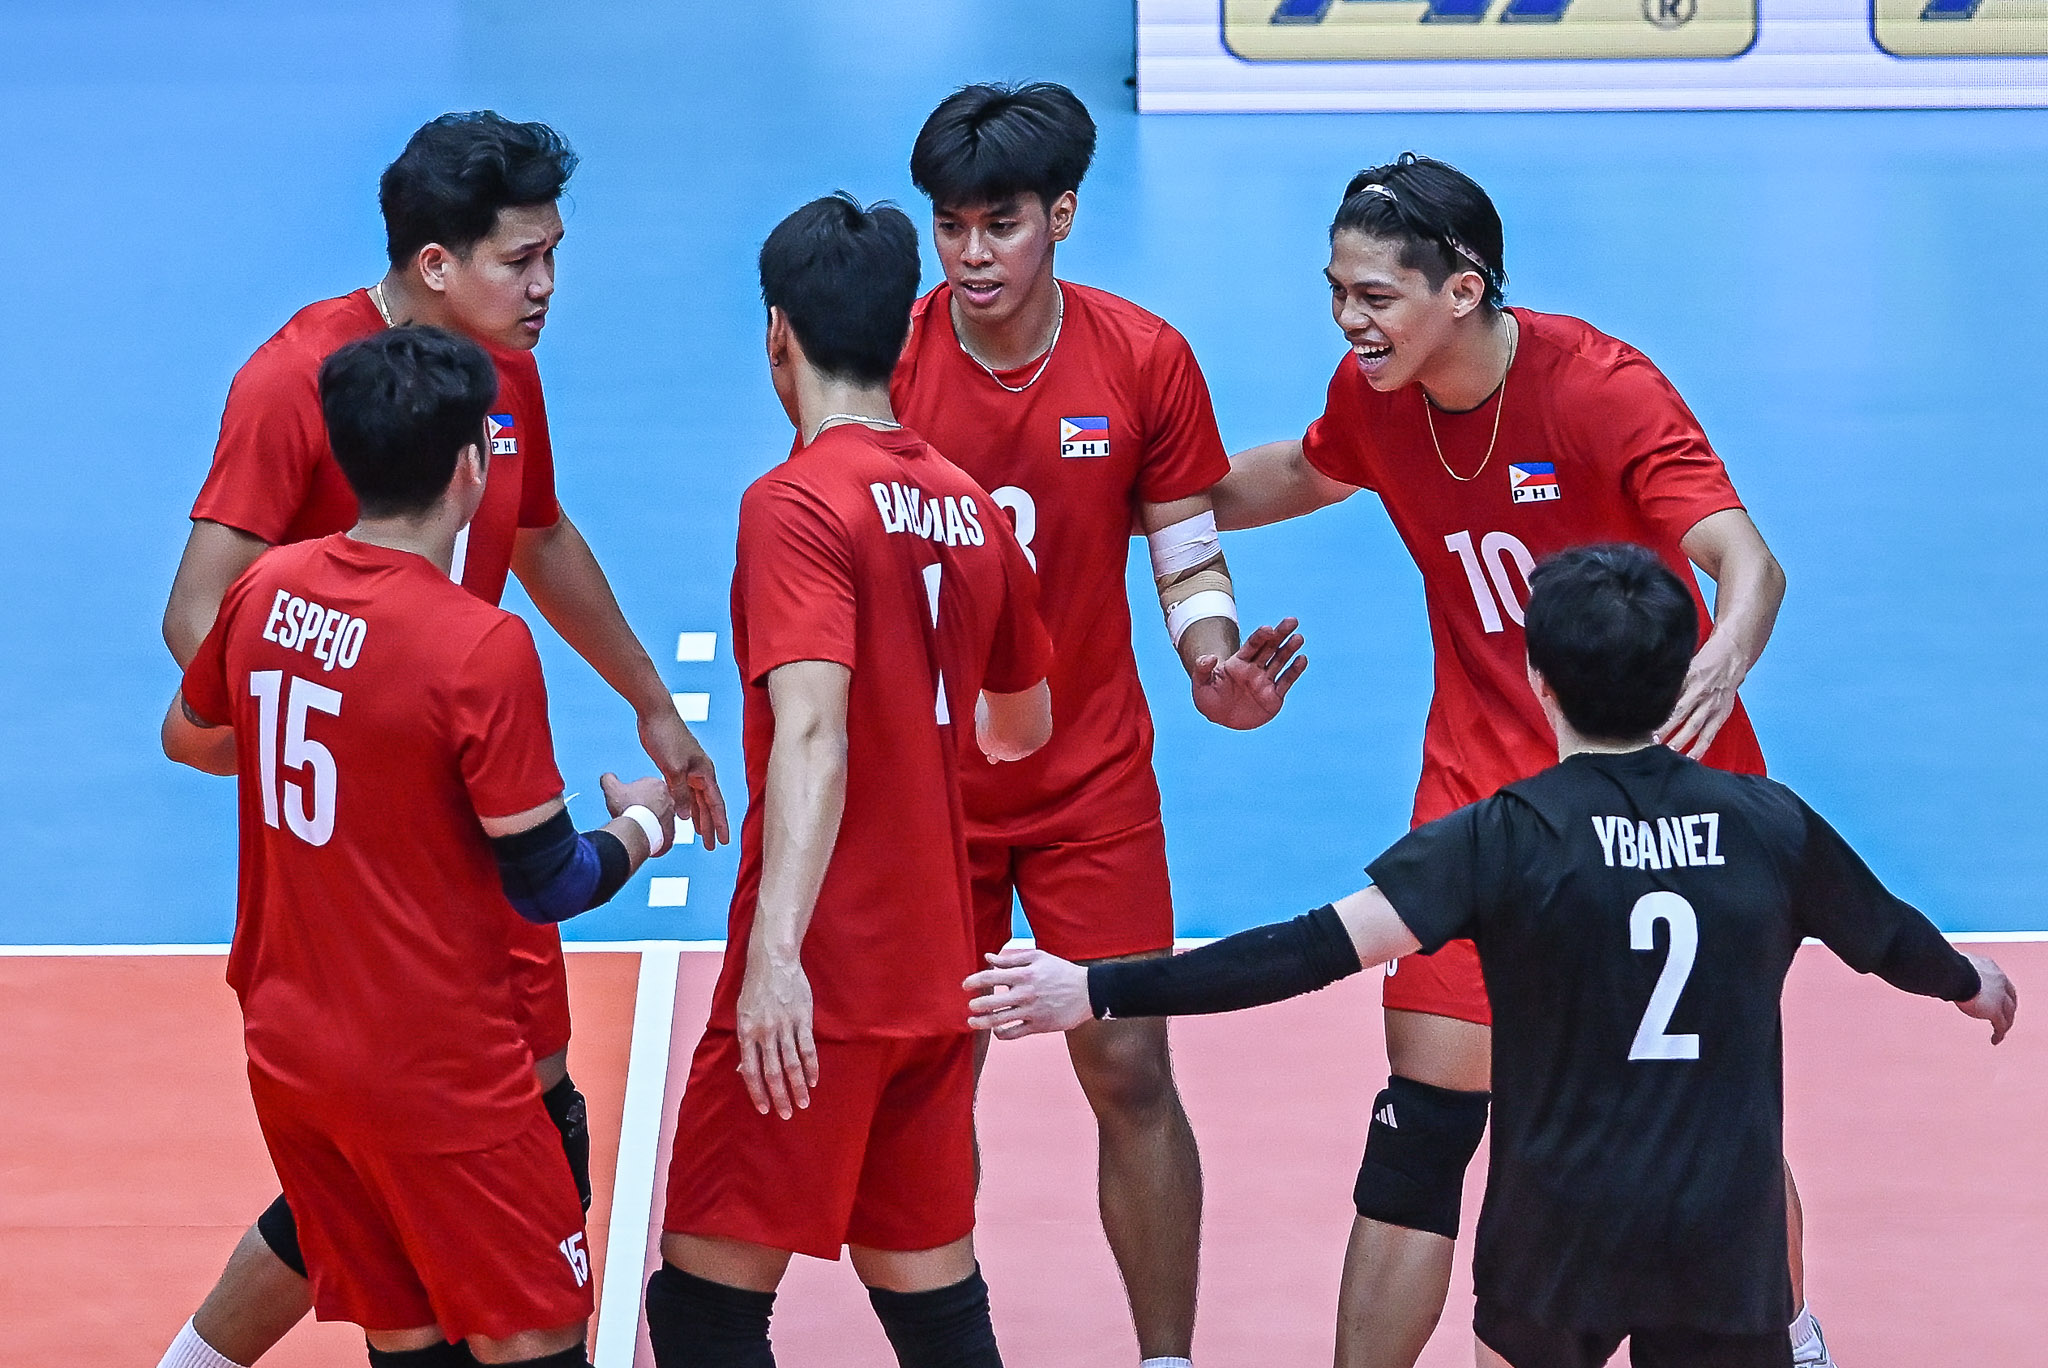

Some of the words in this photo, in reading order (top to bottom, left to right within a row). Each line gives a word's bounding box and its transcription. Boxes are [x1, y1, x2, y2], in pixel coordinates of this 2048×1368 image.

[491, 440, 518, 453] PHI
[1062, 442, 1109, 455] PHI
[1513, 486, 1560, 501] PHI
[1444, 530, 1537, 633] 10
[262, 588, 368, 672] ESPEJO
[250, 669, 343, 847] 15
[1591, 813, 1725, 870] YBANEZ
[1627, 890, 1700, 1060] 2
[558, 1230, 588, 1288] 15
